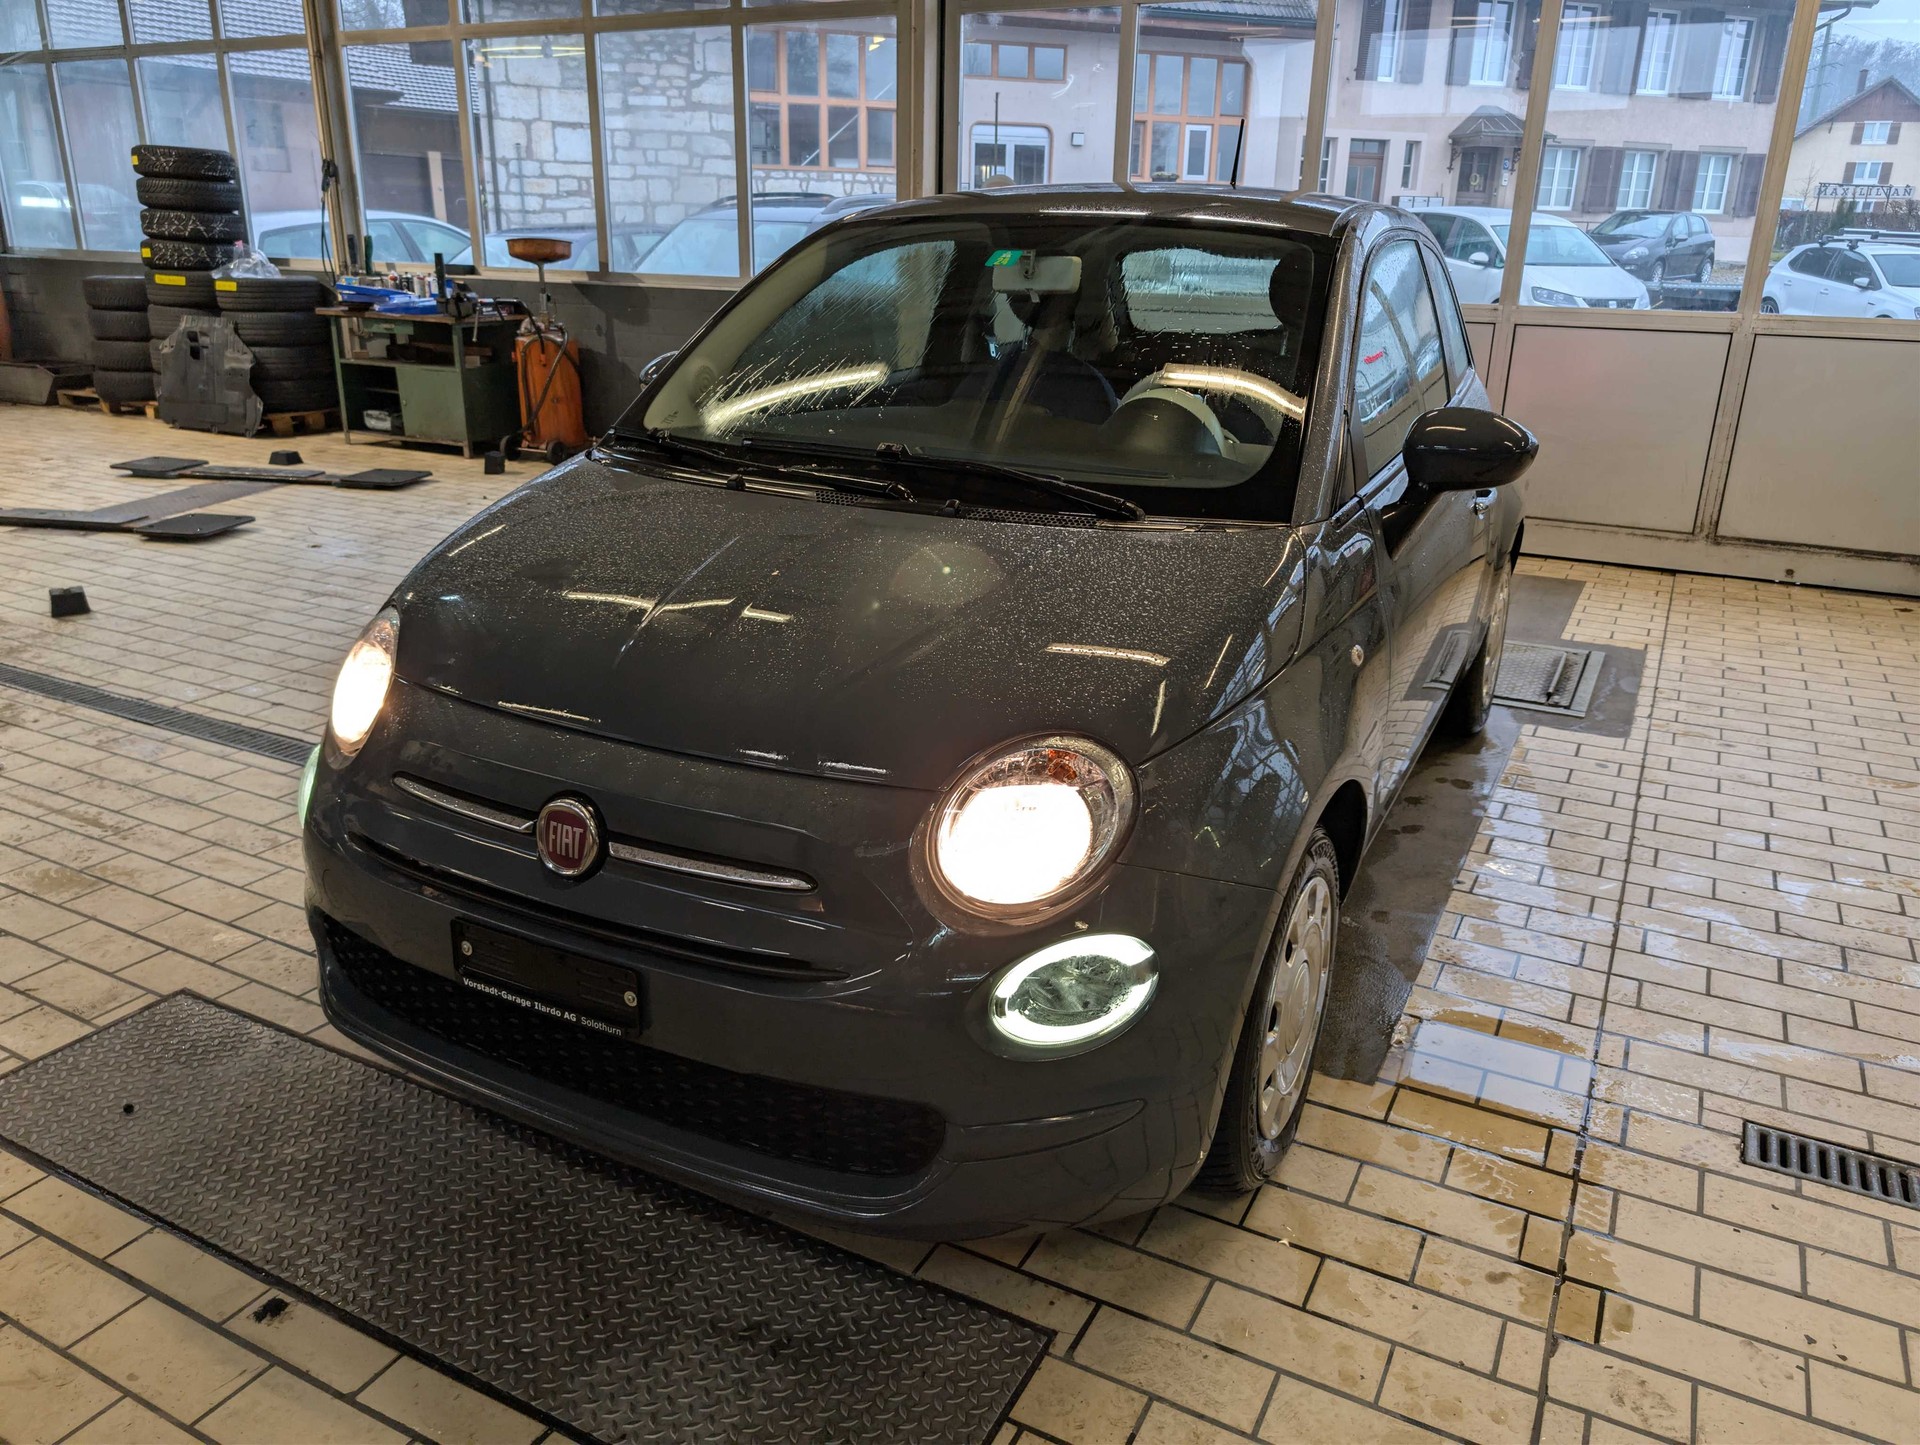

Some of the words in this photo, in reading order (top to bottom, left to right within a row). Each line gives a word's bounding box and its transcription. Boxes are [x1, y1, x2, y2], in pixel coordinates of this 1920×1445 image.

[1816, 187, 1913, 197] MAXLILIAN
[549, 820, 584, 860] FIAT
[462, 976, 532, 1008] Vorstadt-Garage
[533, 1001, 562, 1018] Ilardo
[563, 1011, 577, 1023] AG
[580, 1016, 622, 1036] Solothurn
